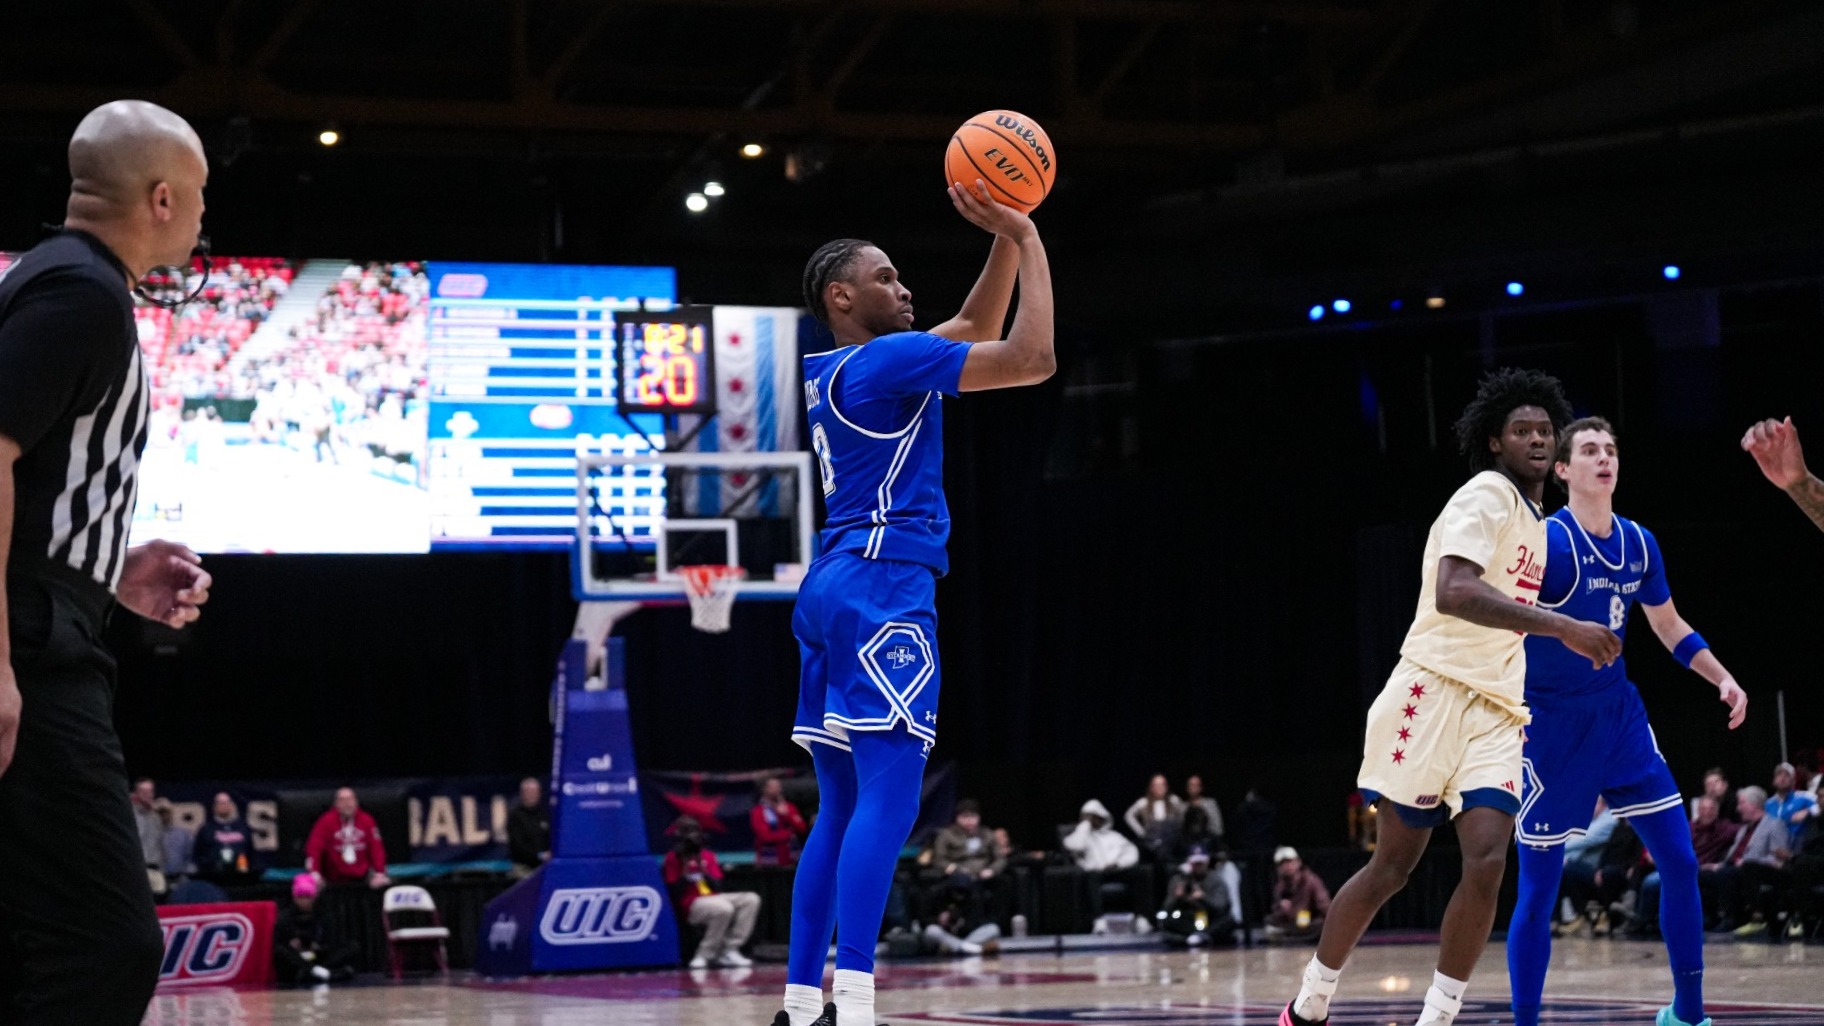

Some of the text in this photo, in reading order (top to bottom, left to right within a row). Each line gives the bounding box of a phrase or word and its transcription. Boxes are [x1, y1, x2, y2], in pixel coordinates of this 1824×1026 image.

[995, 114, 1050, 172] Wilson
[638, 353, 698, 406] 20
[1609, 595, 1625, 630] 8
[545, 890, 657, 941] UIC
[158, 917, 249, 980] IC
